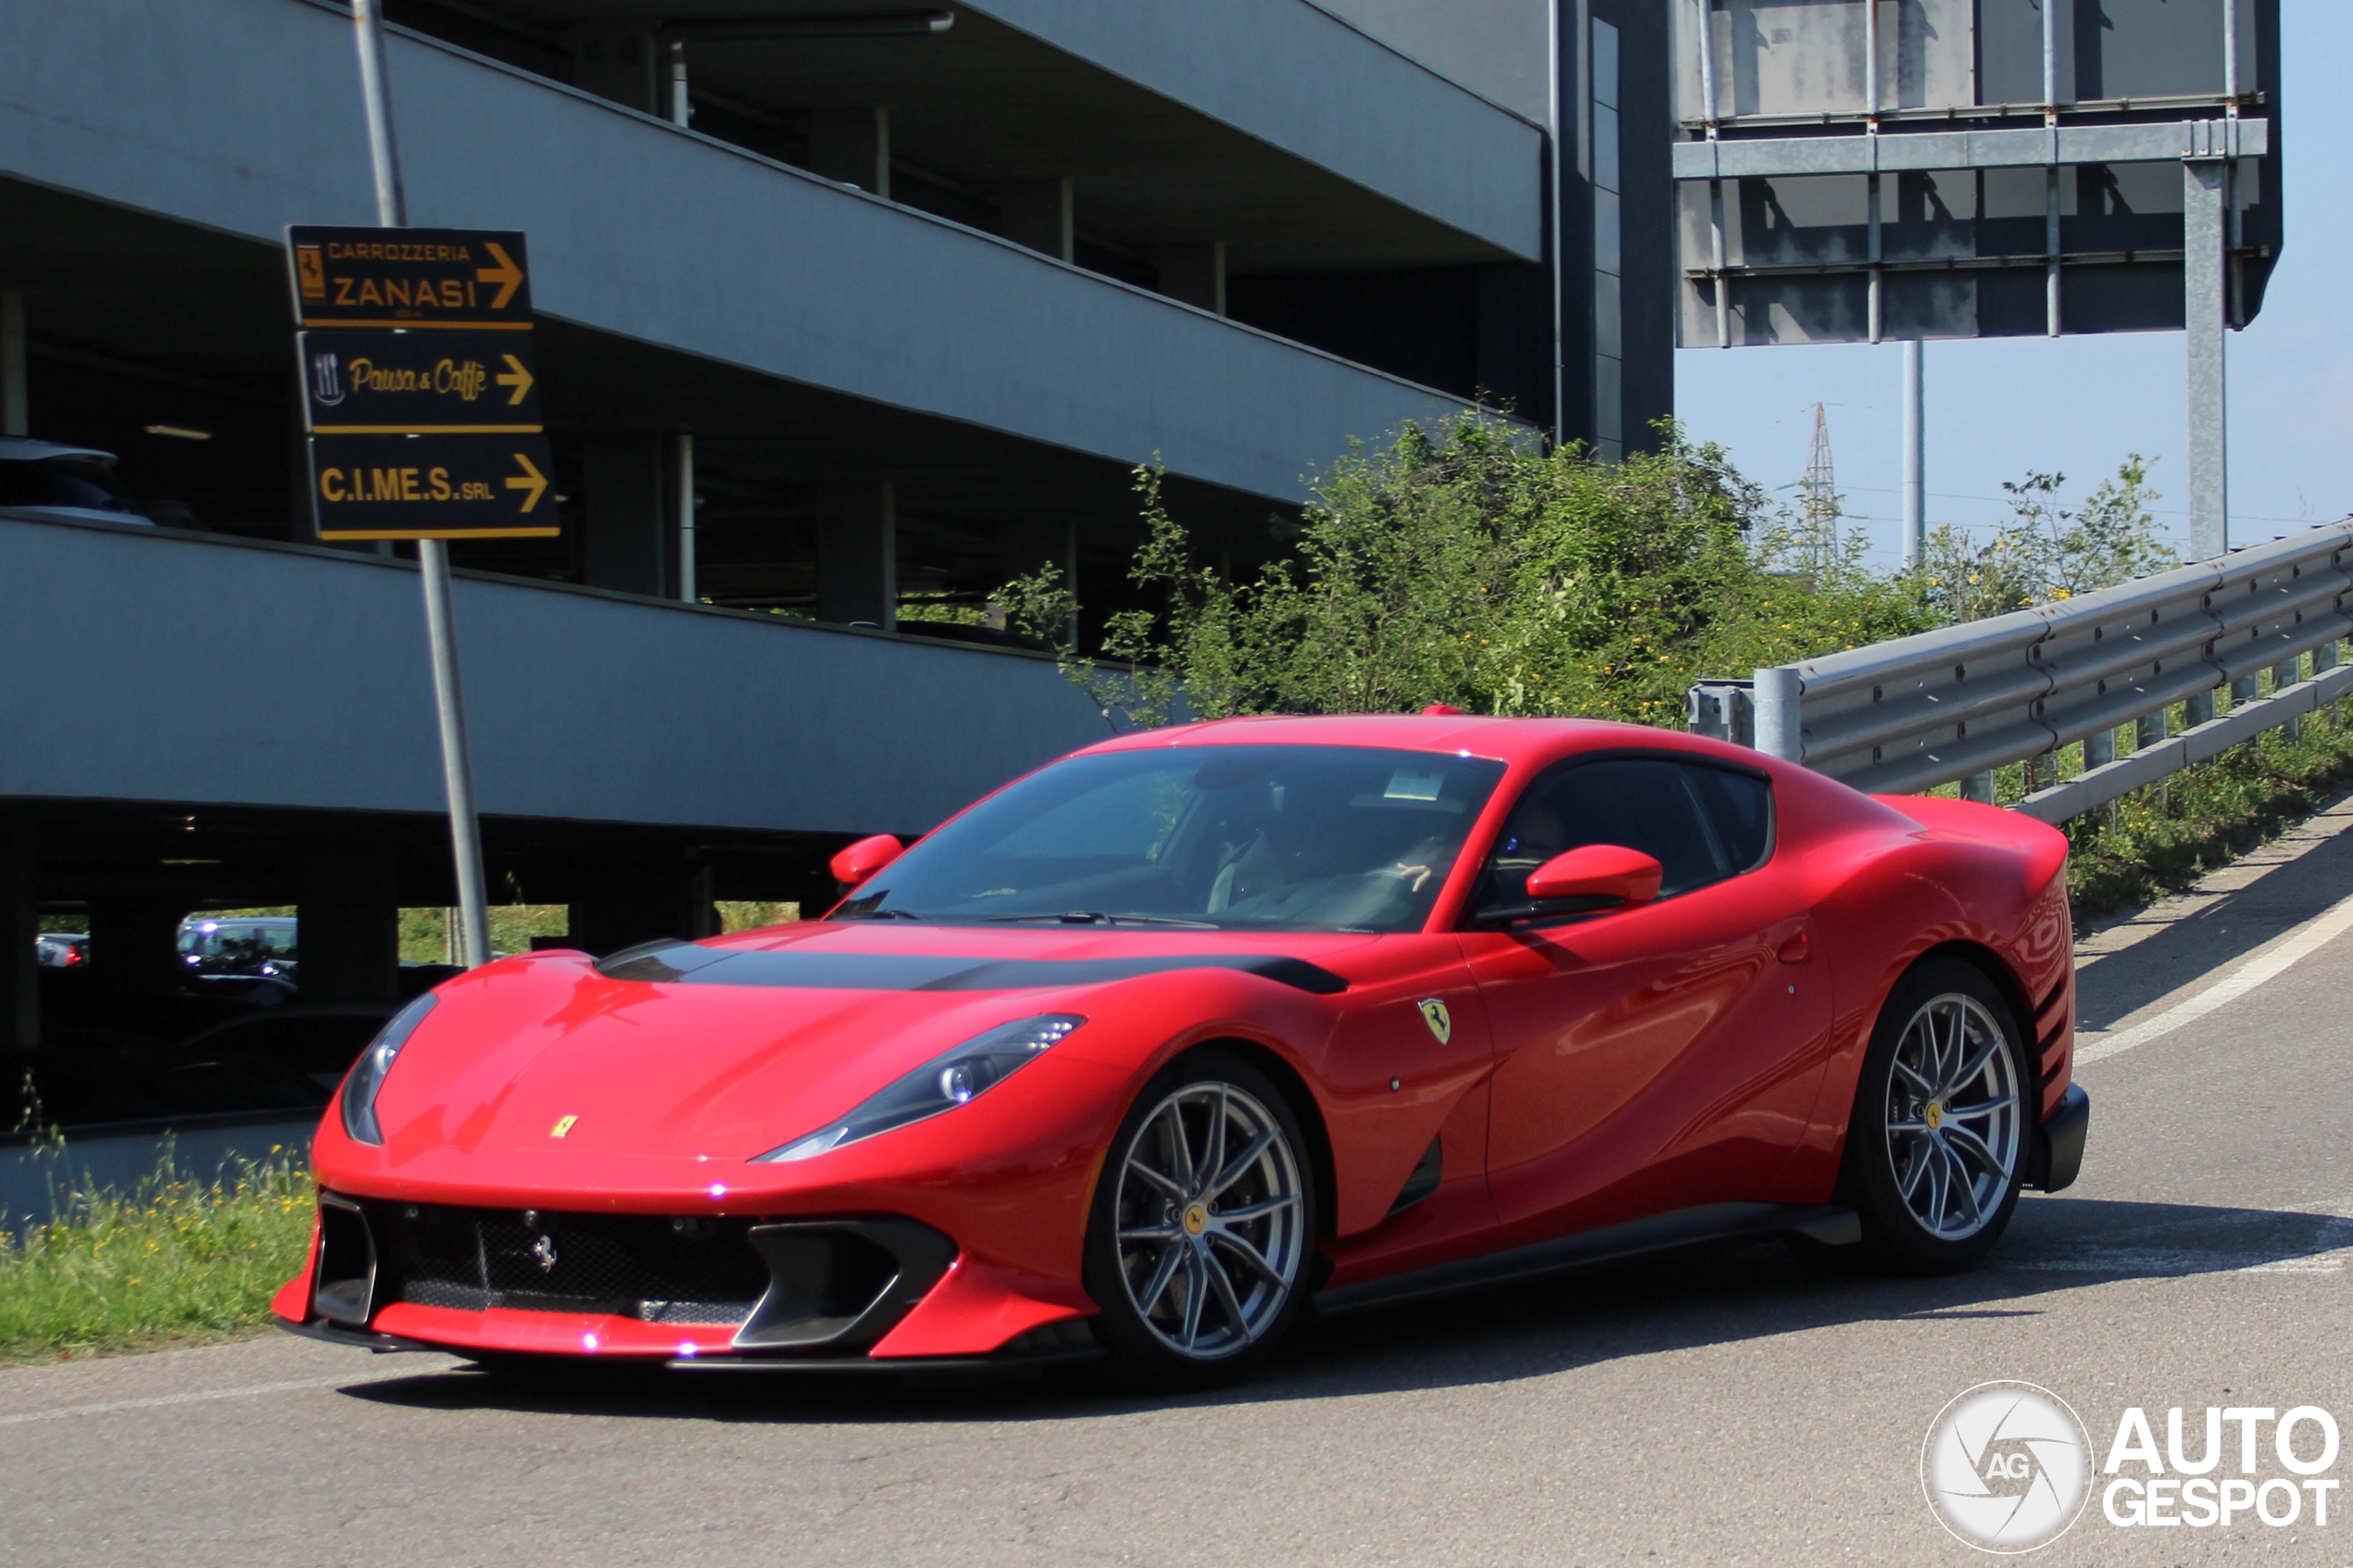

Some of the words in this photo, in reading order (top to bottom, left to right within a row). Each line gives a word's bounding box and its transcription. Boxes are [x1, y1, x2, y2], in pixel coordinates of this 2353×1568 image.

[328, 242, 472, 260] CARROZZERIA
[333, 277, 476, 307] ZANASI
[349, 358, 417, 393] Pausa
[420, 372, 431, 389] &
[434, 358, 487, 400] Caffè
[321, 468, 460, 502] C.I.ME.S.
[462, 483, 495, 500] SRL
